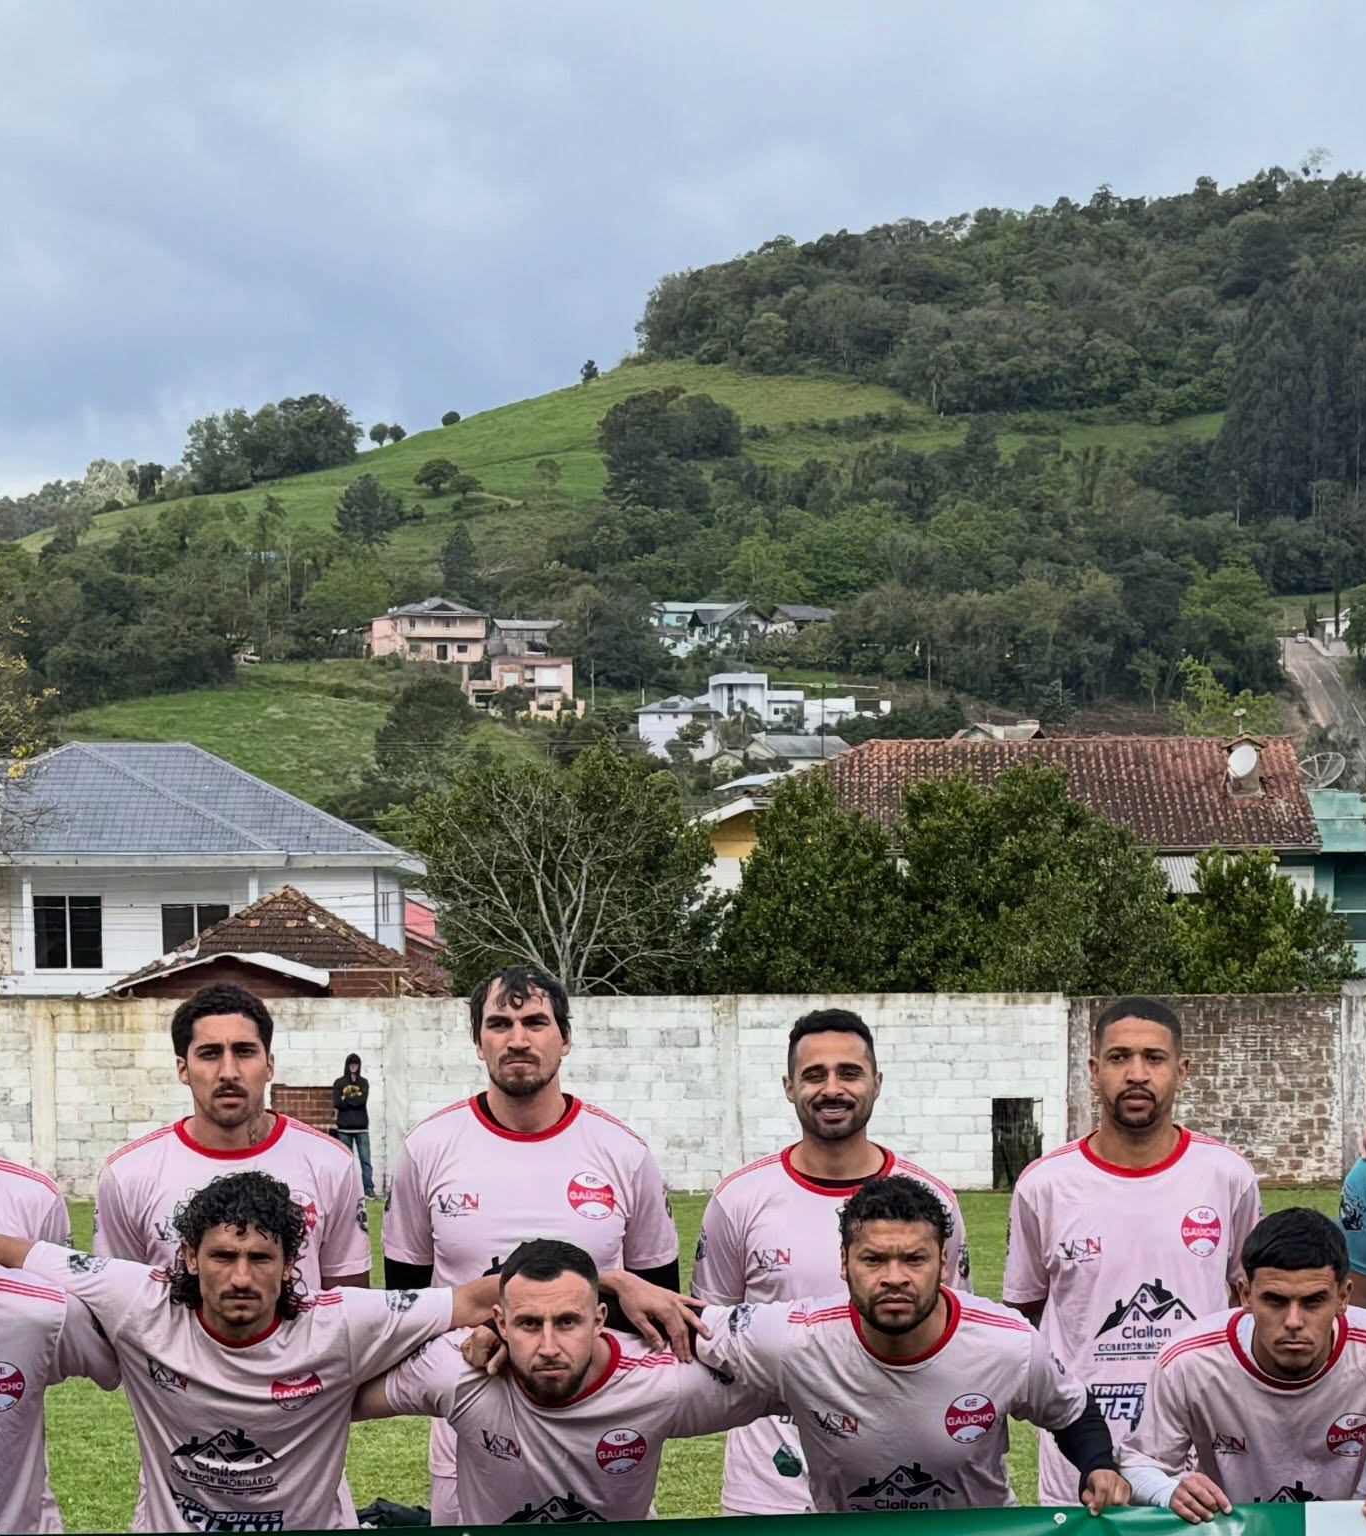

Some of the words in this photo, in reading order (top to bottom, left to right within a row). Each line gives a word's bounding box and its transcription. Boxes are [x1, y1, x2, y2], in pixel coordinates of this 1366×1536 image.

[437, 1193, 479, 1212] VSN
[964, 1398, 978, 1407] GE
[946, 1412, 994, 1428] GAÚCHO
[597, 1444, 645, 1460] GAÚCHO
